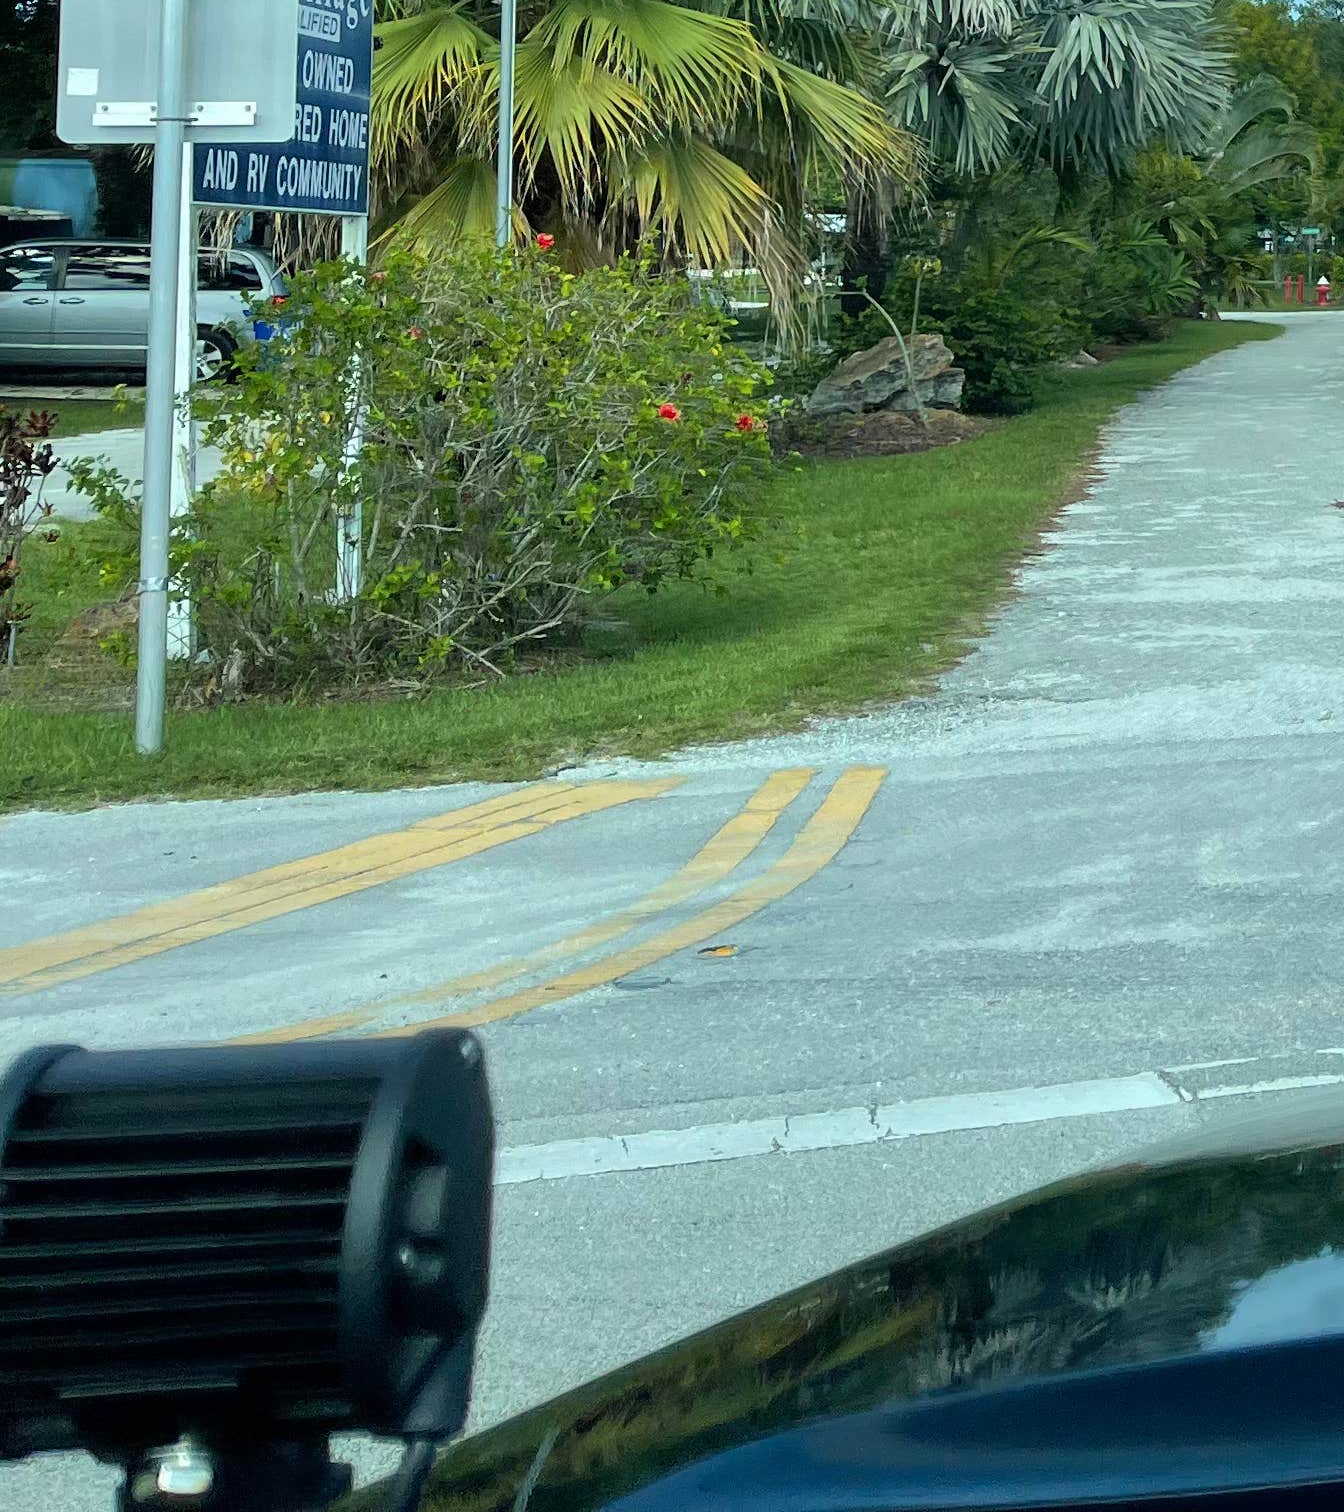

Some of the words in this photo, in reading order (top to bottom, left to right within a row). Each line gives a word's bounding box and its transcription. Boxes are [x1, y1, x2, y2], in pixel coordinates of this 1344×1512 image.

[302, 49, 354, 94] OWNED
[328, 108, 368, 149] HOME
[202, 148, 239, 191] AND
[246, 152, 269, 193] RV
[276, 155, 362, 201] COMMUNITY
